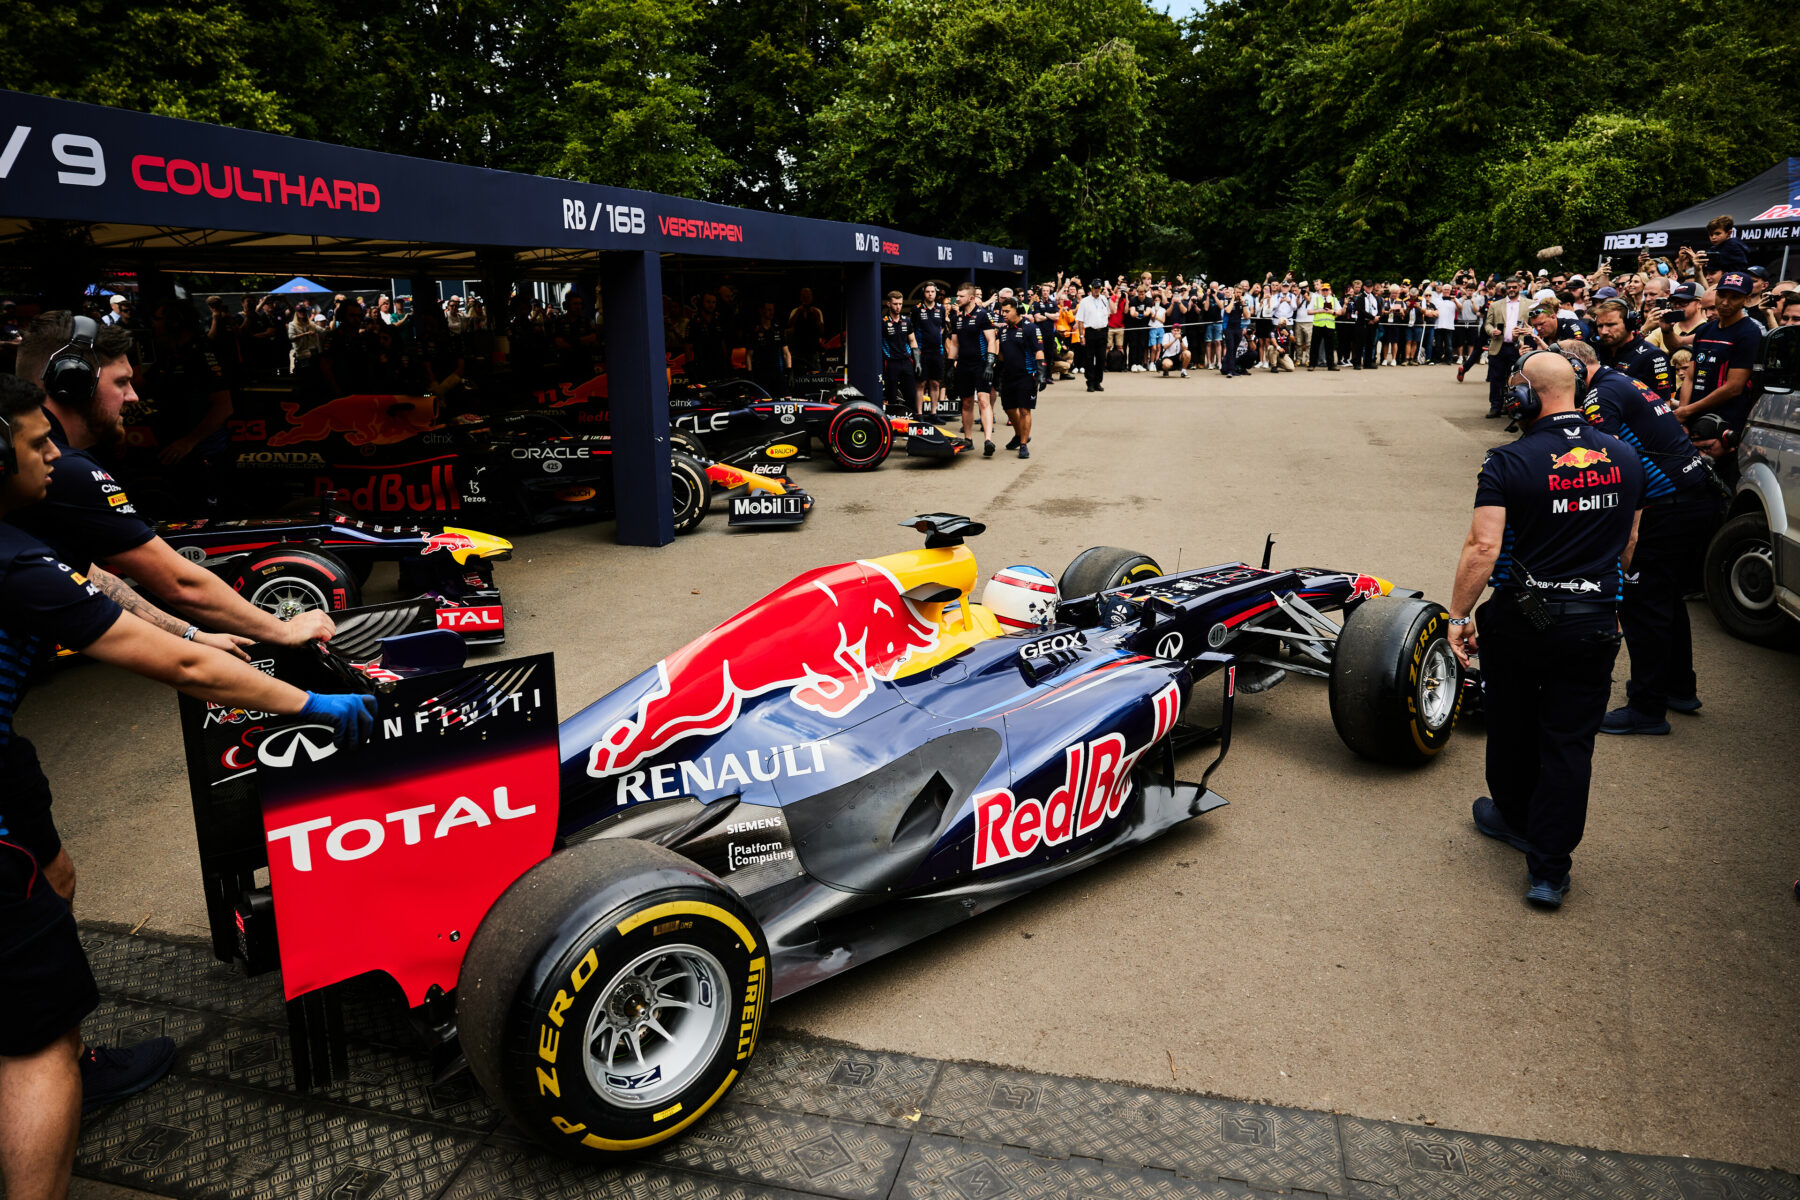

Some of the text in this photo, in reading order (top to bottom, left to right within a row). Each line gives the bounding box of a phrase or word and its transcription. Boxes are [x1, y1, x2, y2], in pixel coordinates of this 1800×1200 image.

[131, 155, 380, 212] COULTHARD
[658, 215, 743, 243] VERSTAPPEN
[1741, 229, 1762, 240] MAD
[1764, 226, 1789, 239] MIKE
[923, 401, 949, 411] Mbil
[908, 426, 935, 436] Mobil
[236, 452, 327, 463] HONDA
[511, 447, 590, 459] ORACLE
[752, 463, 785, 475] telcel
[734, 498, 782, 515] Mobil
[1552, 494, 1617, 514] Mobil 1
[1020, 630, 1083, 660] GEOX
[1409, 616, 1438, 687] ZERO
[1228, 665, 1236, 698] 1
[366, 688, 541, 744] NFINITI
[616, 739, 831, 806] RENAULT
[267, 786, 537, 872] TOTAL
[726, 816, 782, 834] SIEMENS
[734, 841, 782, 856] Platform
[735, 850, 794, 866] Computing
[736, 955, 766, 1061] PIRELLI
[535, 947, 600, 1098] ZERO
[551, 1115, 587, 1135] P
